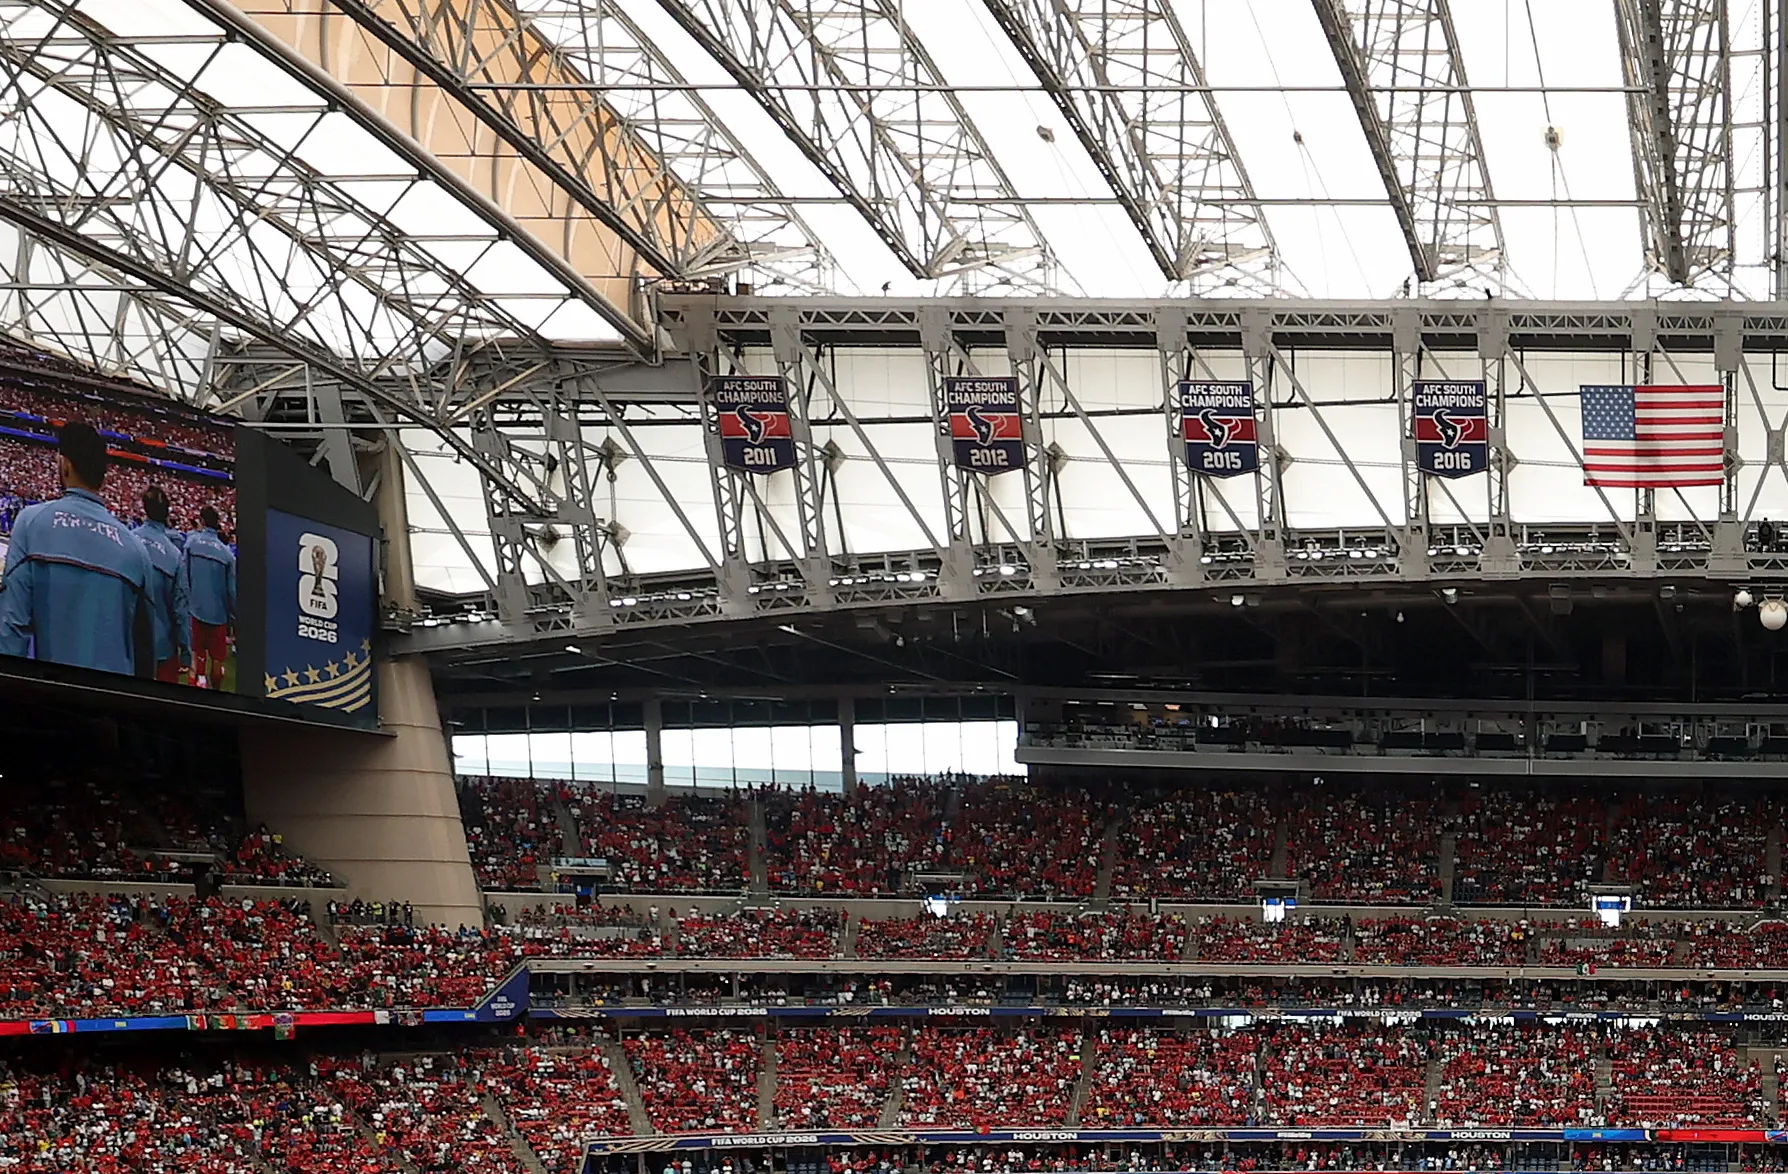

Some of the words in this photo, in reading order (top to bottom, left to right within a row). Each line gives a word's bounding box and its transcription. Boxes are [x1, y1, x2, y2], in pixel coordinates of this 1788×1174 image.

[723, 382, 741, 391] AFC
[743, 381, 776, 390] SOUTH
[955, 382, 973, 391] AFC
[975, 382, 1007, 391] SOUTH
[1189, 385, 1207, 395] AFC
[1209, 385, 1242, 395] SOUTH
[1423, 385, 1441, 395] AFC
[1443, 385, 1476, 395] SOUTH
[717, 392, 784, 403] CHAMPIONS
[949, 393, 1015, 404] CHAMPIONS
[1182, 396, 1251, 408] CHAMPIONS
[1416, 396, 1483, 407] CHAMPIONS
[743, 448, 777, 466] 2011
[970, 449, 1008, 466] 2012
[1203, 452, 1241, 469] 2015
[1434, 452, 1471, 469] 2016
[310, 599, 327, 610] FIFA
[299, 616, 323, 628] WORLD
[324, 620, 337, 630] CUP
[298, 625, 337, 643] 2026
[733, 1137, 765, 1145] WORLD
[1013, 1132, 1077, 1140] HOUSTON
